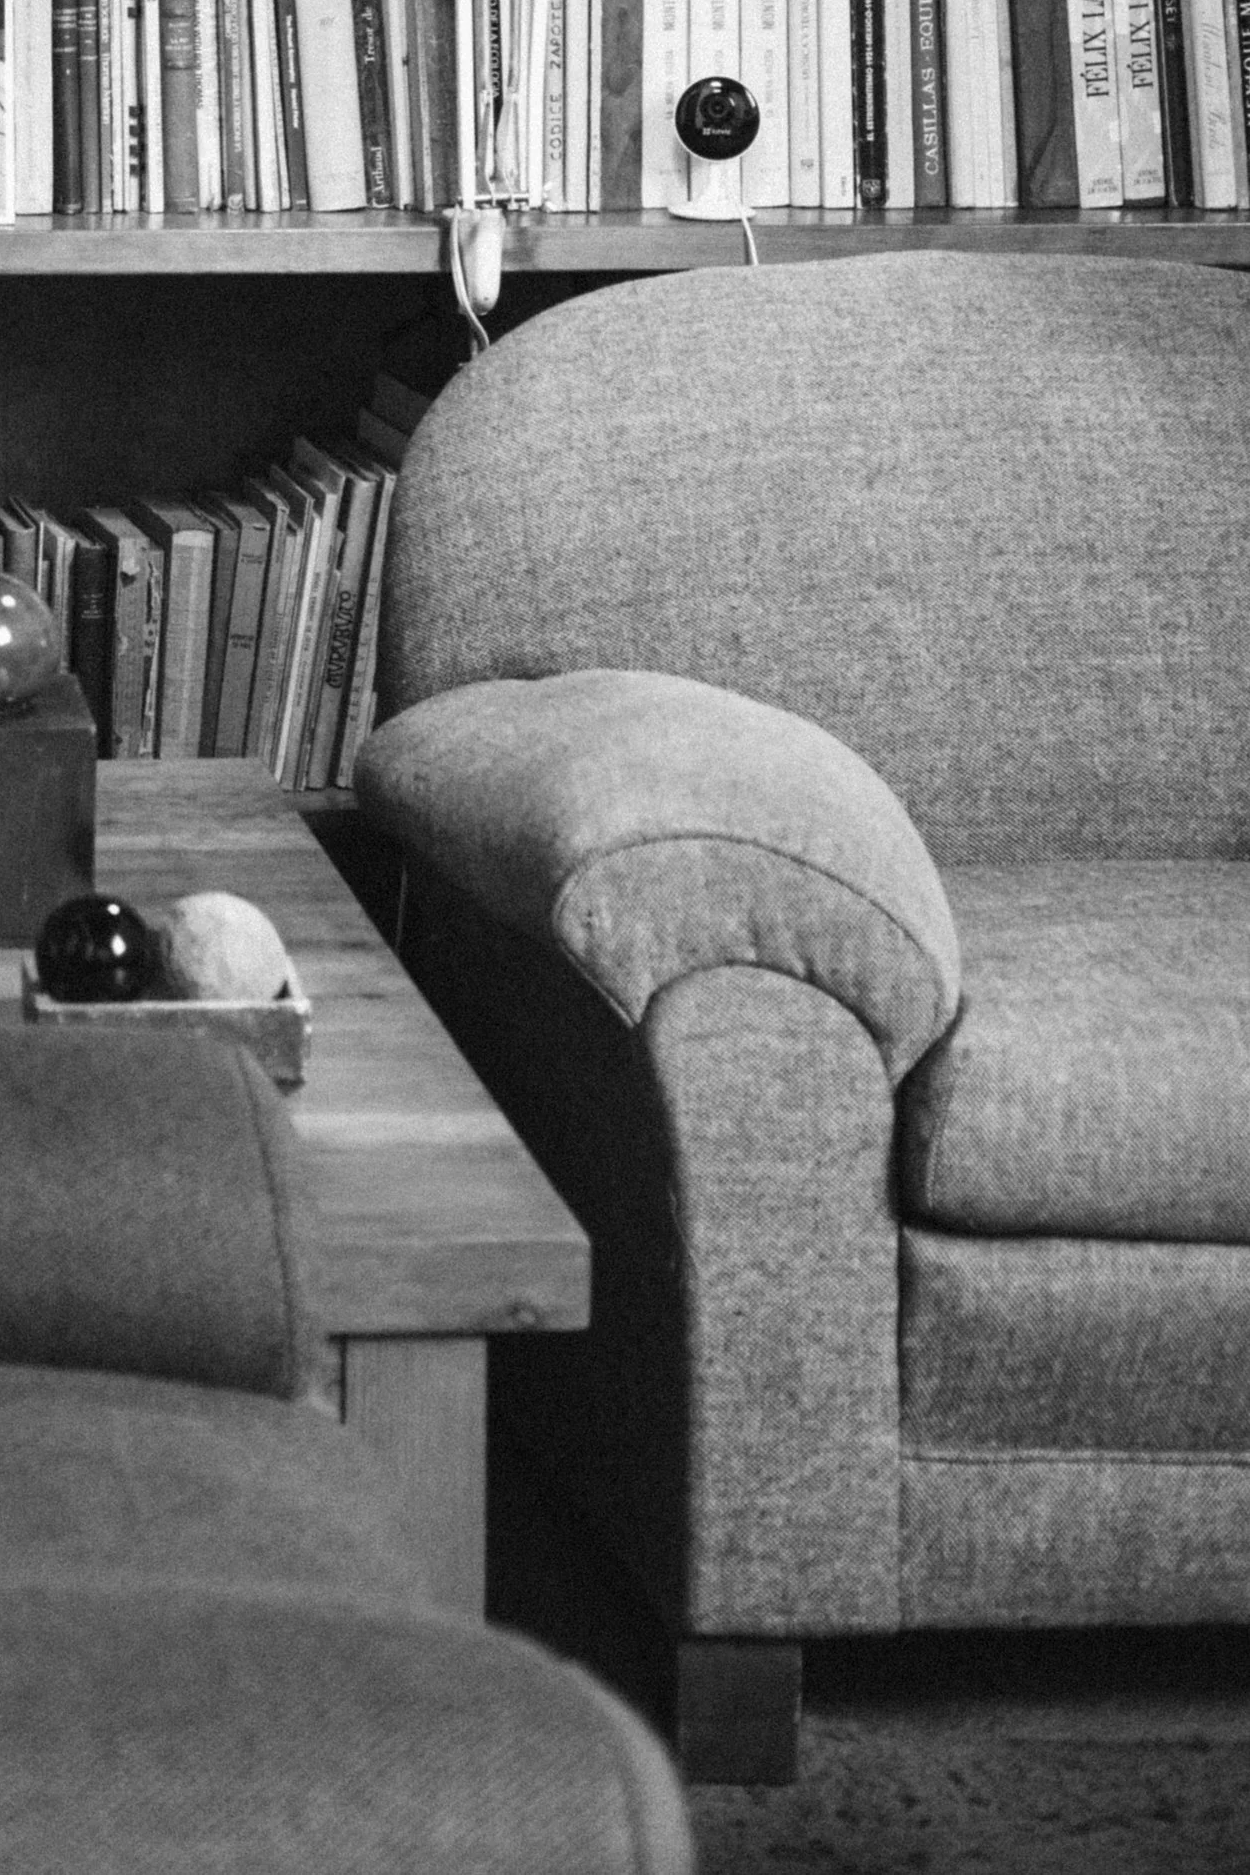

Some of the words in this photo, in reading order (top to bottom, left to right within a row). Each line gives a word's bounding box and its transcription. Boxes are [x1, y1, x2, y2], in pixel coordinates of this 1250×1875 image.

[360, 5, 373, 21] de
[1077, 26, 1111, 98] FÉLIX
[1124, 19, 1154, 90] FÉLIX
[549, 91, 561, 161] CODICE
[865, 66, 874, 130] ESTRIDENTISMO
[920, 66, 940, 175] CASILLAS
[369, 145, 385, 194] Arthaud
